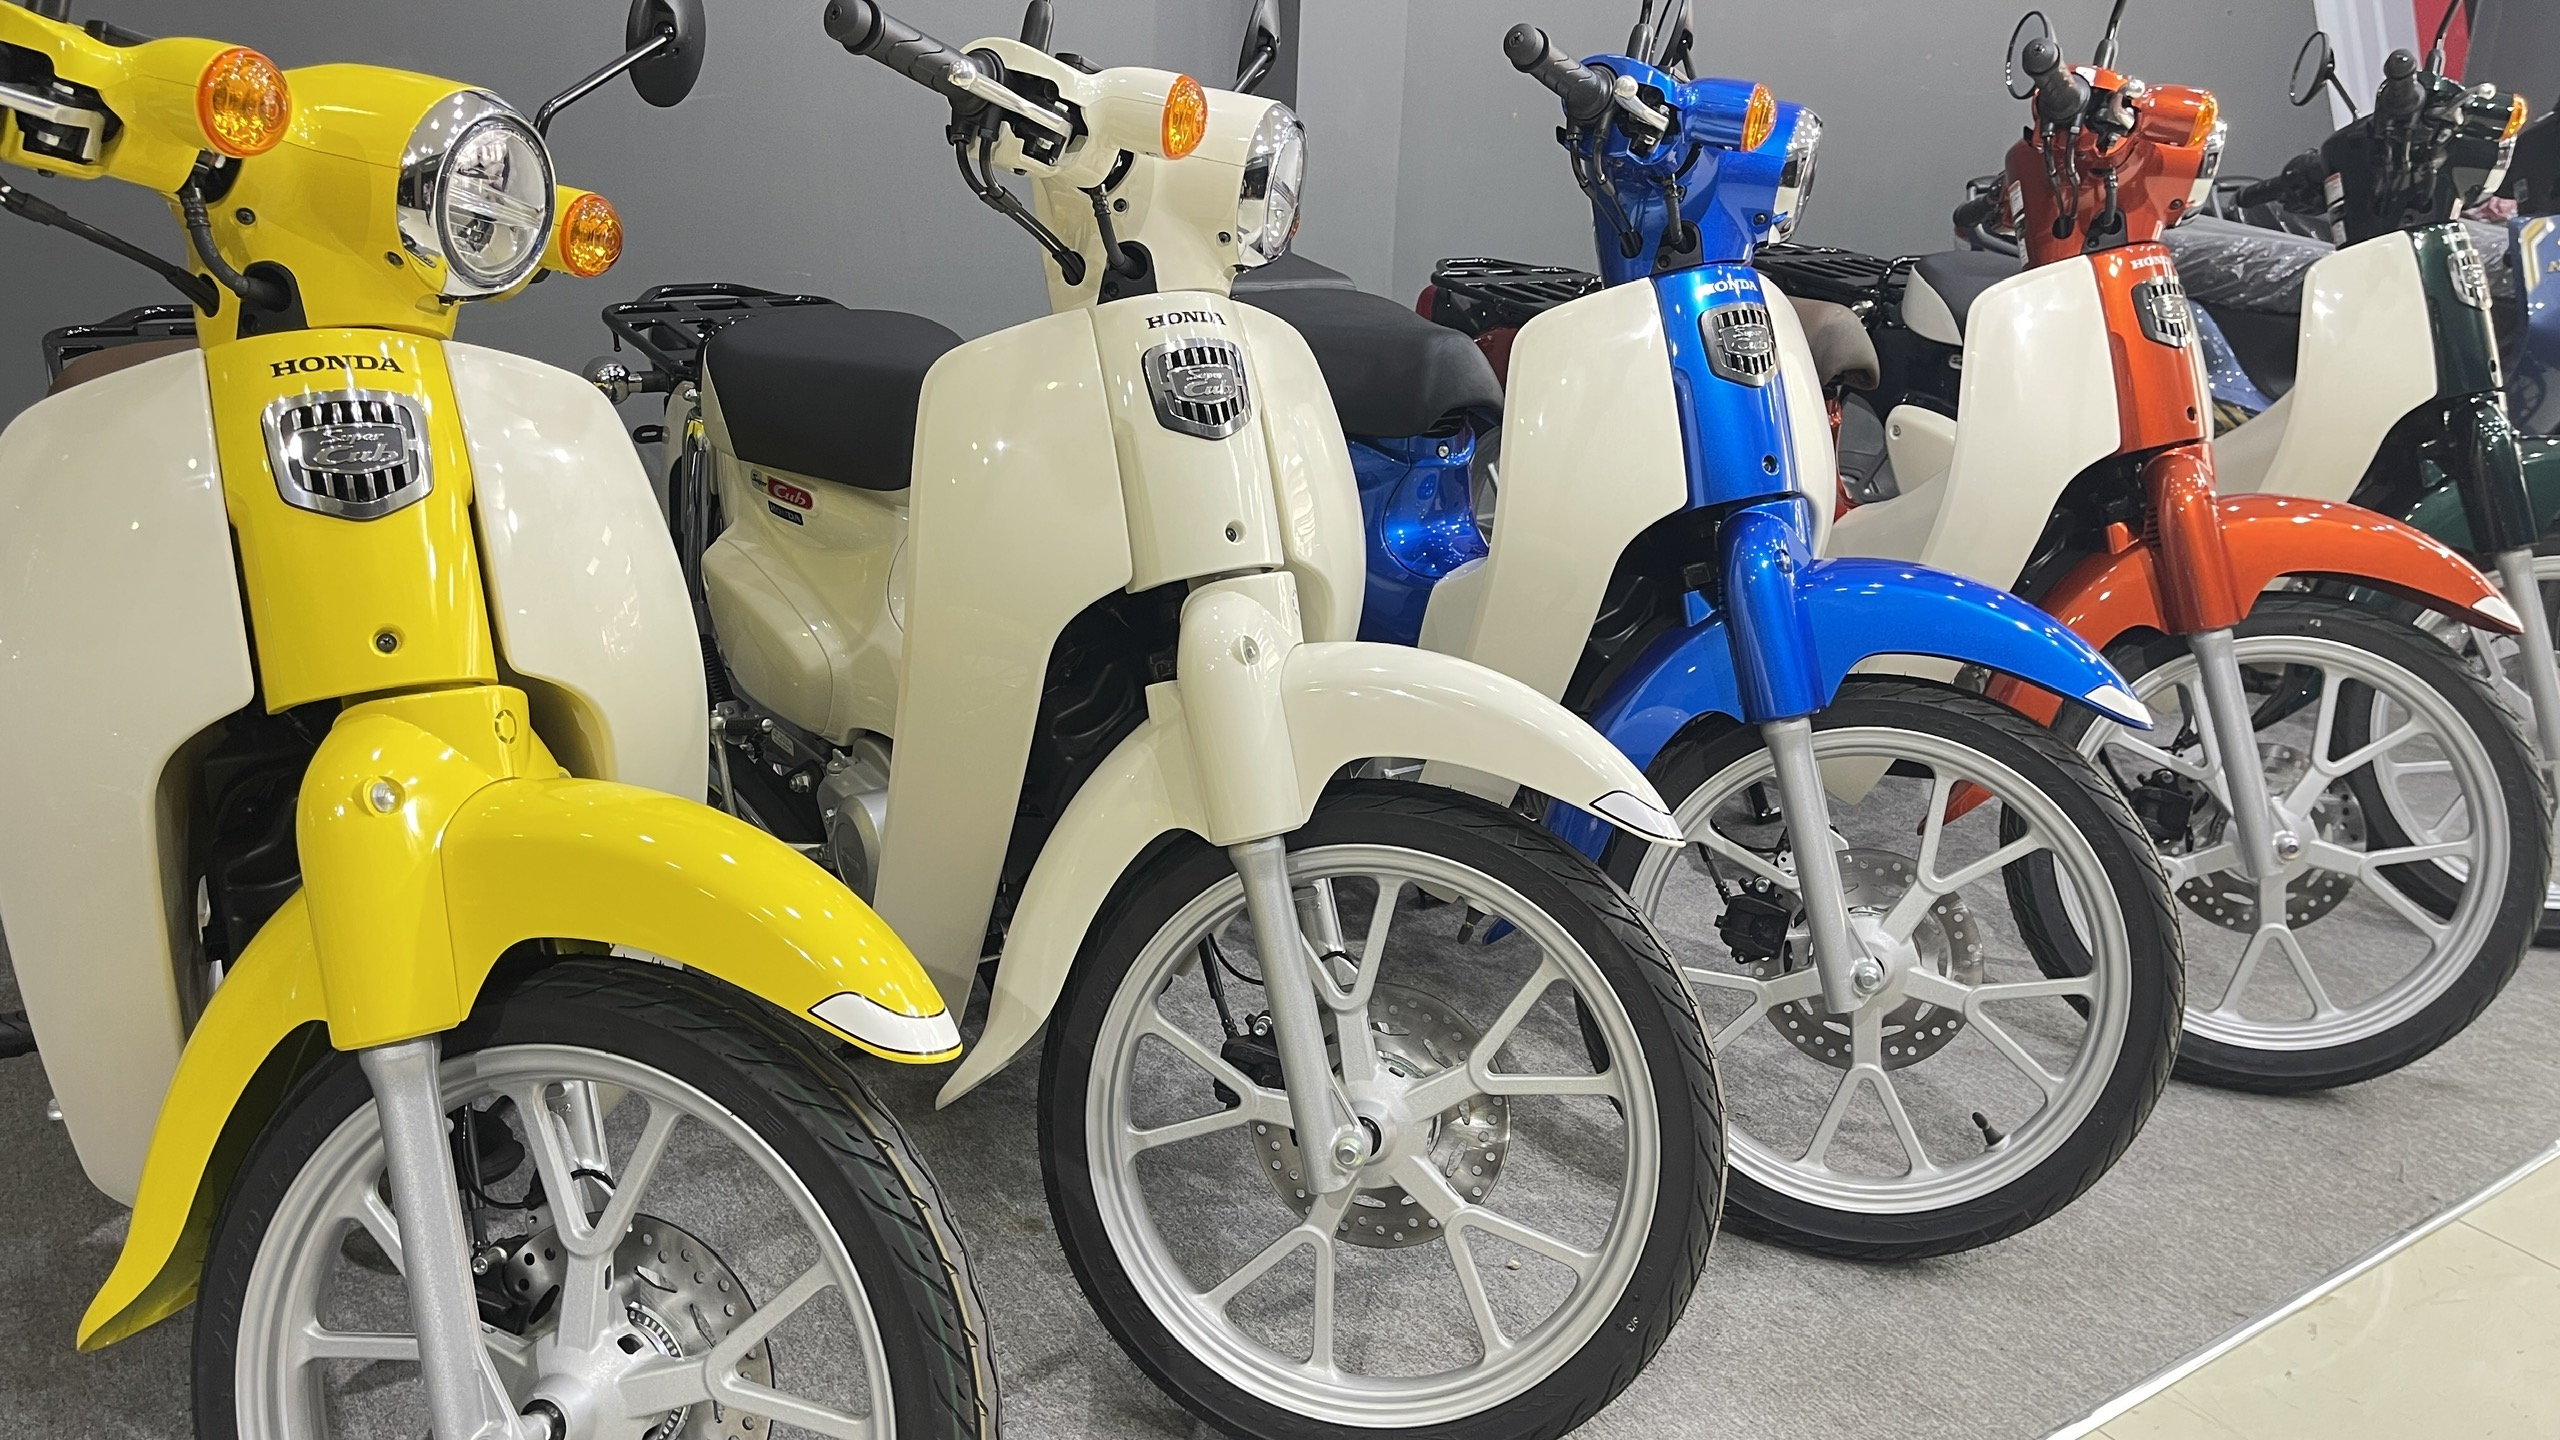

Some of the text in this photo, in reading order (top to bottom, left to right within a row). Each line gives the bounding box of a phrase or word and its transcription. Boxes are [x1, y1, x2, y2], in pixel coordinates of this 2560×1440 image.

[1146, 311, 1226, 329] HONDA
[270, 355, 404, 378] HONDA
[1186, 368, 1224, 382] Super
[1183, 379, 1232, 397] Cub
[320, 428, 384, 446] Super
[313, 442, 399, 465] Cub
[773, 484, 806, 505] Cub
